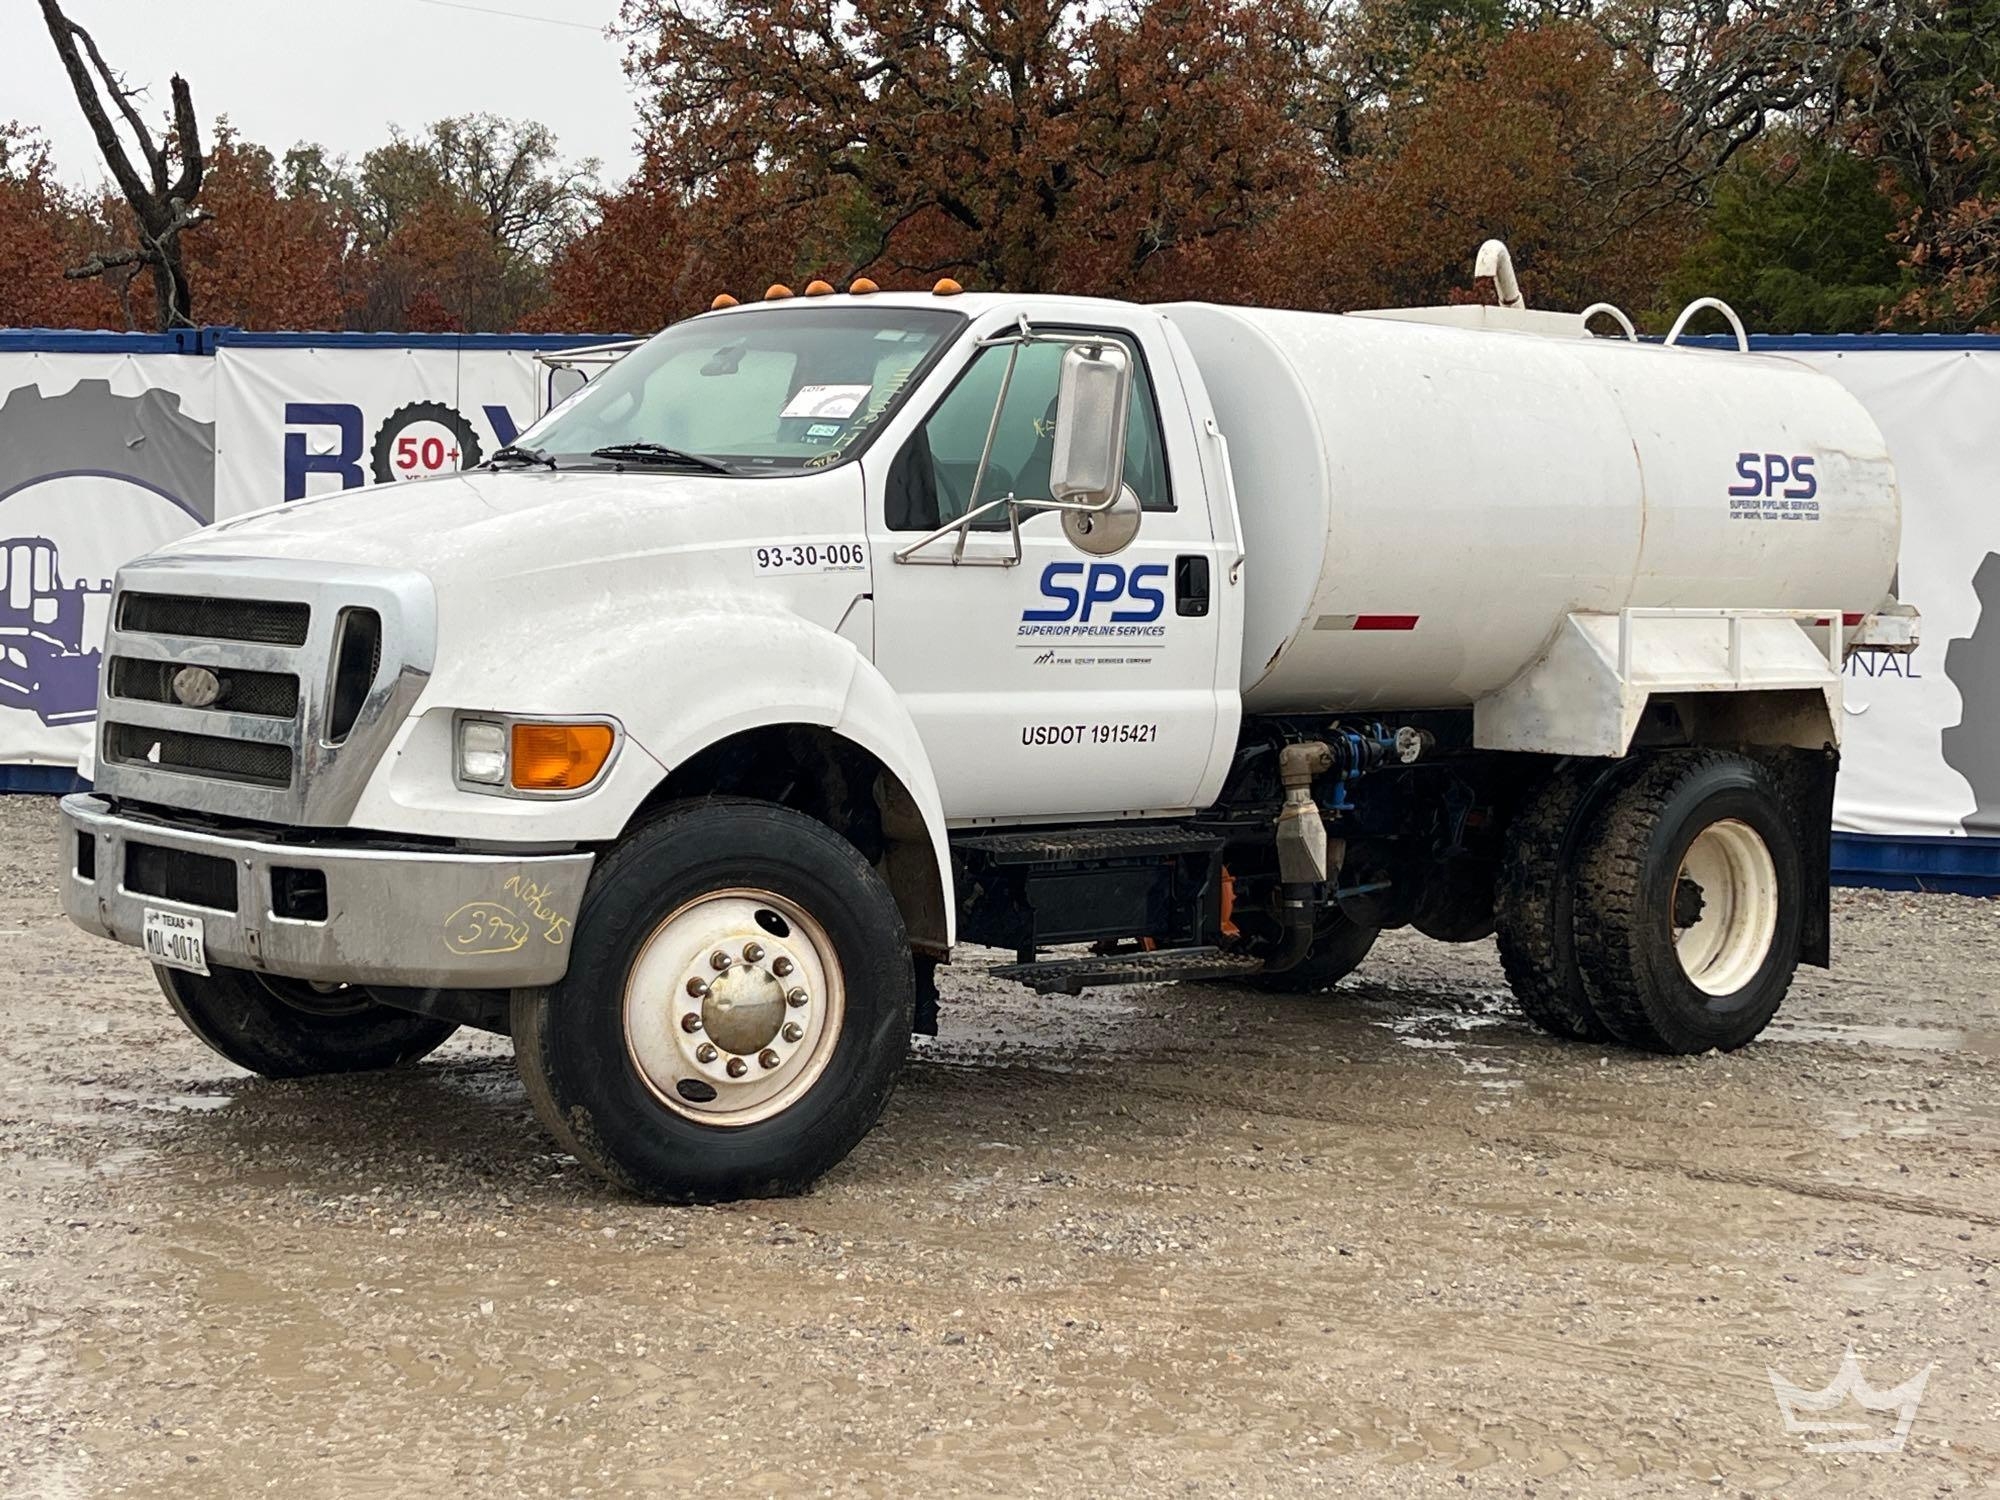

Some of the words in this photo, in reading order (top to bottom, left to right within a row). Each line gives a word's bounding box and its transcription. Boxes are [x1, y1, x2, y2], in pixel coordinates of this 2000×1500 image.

[396, 437, 460, 470] 50+
[1728, 452, 1817, 499] SPS
[757, 544, 864, 568] 93-30-006
[1021, 562, 1169, 623] SPS
[1017, 625, 1071, 636] SUPERIOR
[1071, 625, 1115, 636] PIPELINE
[1116, 625, 1166, 637] SERVICES
[1841, 651, 1922, 678] NAL
[1022, 725, 1086, 745] USDOT
[1091, 724, 1157, 744] 1915421
